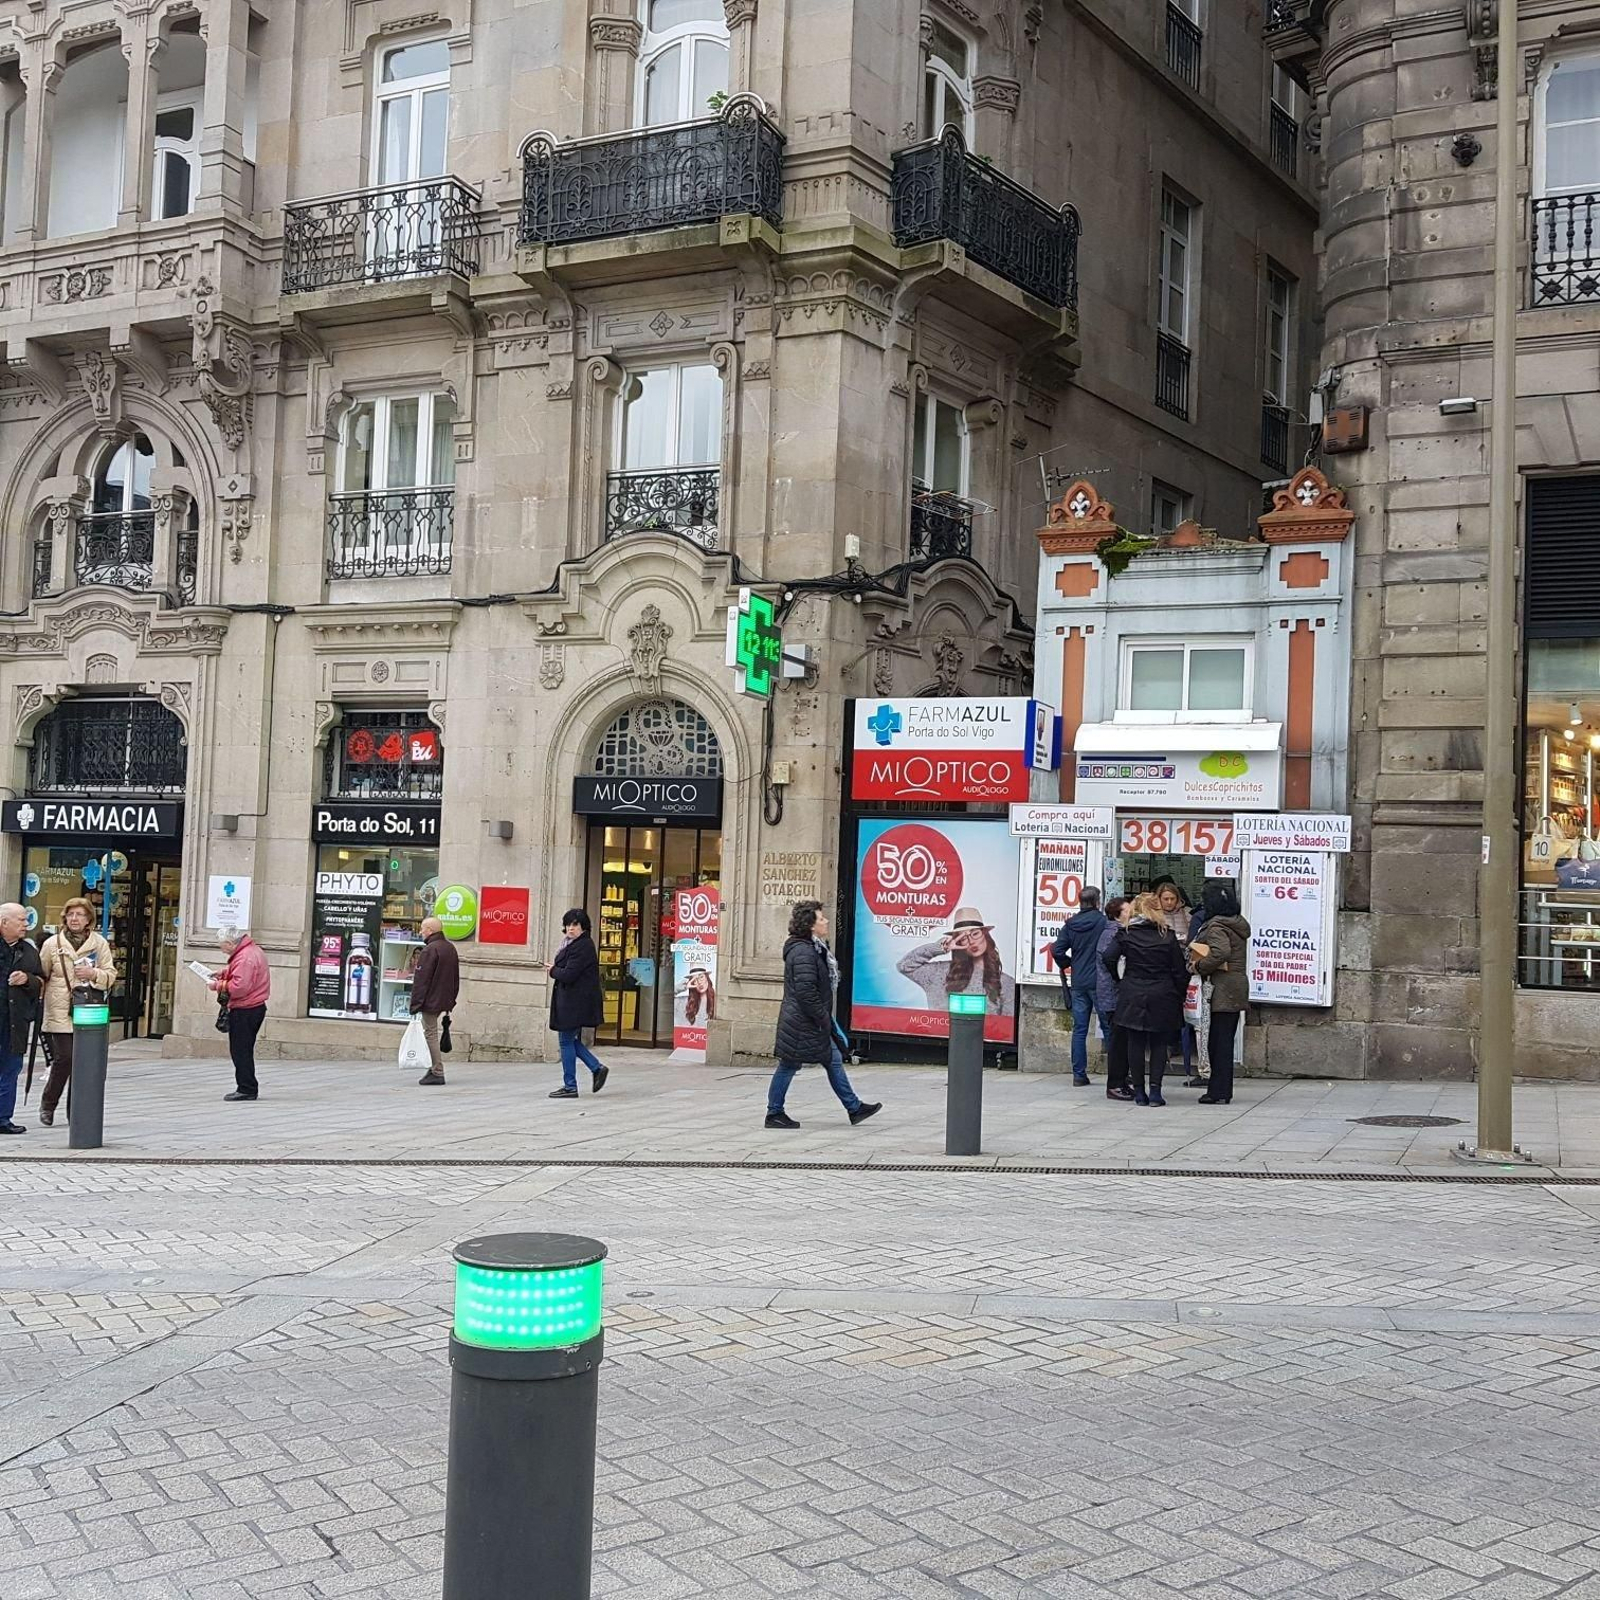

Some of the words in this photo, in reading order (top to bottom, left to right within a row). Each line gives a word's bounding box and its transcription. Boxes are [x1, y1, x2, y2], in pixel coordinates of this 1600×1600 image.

[908, 705, 1011, 723] FARMAZUL
[908, 726, 934, 737] Porta
[937, 726, 949, 737] do
[953, 726, 968, 737] Sol
[973, 725, 994, 740] Vigo
[870, 757, 1011, 787] MIOPTICO
[593, 780, 697, 804] MIOPTICO
[962, 785, 1009, 796] AUDIOLOGO
[1184, 782, 1263, 794] DulcesCaprichitos
[42, 804, 160, 833] FARMACIA
[1027, 810, 1068, 823] Compra
[1073, 808, 1095, 820] aquí
[317, 811, 357, 832] Porta
[360, 817, 379, 832] do
[383, 812, 415, 836] Sol,
[420, 818, 435, 834] 11
[1064, 823, 1109, 834] Nacional
[1236, 815, 1286, 831] LOTERÍA
[1288, 819, 1349, 833] NACIONAL
[1123, 820, 1168, 852] 38
[1176, 821, 1234, 854] 157
[1253, 833, 1282, 846] Jueves
[1285, 836, 1291, 848] y
[1293, 834, 1331, 847] Sábados
[1039, 842, 1084, 856] MAÑANA
[763, 852, 817, 866] ALBERTO
[1038, 857, 1084, 873] EUROMILLONES
[1263, 854, 1311, 866] LOTERÍA
[763, 868, 817, 881] SANCHEZ
[1257, 865, 1317, 875] NACIONAL
[320, 874, 379, 890] PHYTO
[935, 876, 947, 885] EN
[1254, 876, 1279, 884] SORTEO
[1281, 877, 1292, 885] DEL
[763, 884, 815, 896] OTAEGUI
[1038, 875, 1083, 907] 50
[1274, 886, 1299, 900] 6€
[876, 891, 947, 906] MONTURAS
[482, 910, 525, 921] MIOPTICO
[889, 916, 922, 924] SEGUNDAS
[924, 918, 944, 926] GAFAS
[1040, 911, 1076, 922] DOMING
[678, 925, 718, 934] MONTURAS
[891, 924, 928, 936] GRATIS
[1259, 928, 1310, 940] LOTERÍA
[1252, 939, 1317, 951] NACIONAL
[684, 952, 712, 963] GRATIS
[1256, 950, 1282, 959] SORTEO
[1283, 952, 1315, 961] ESPECIAL
[1273, 961, 1285, 969] DEL
[1252, 969, 1264, 981] 15
[1266, 970, 1316, 985] Millones
